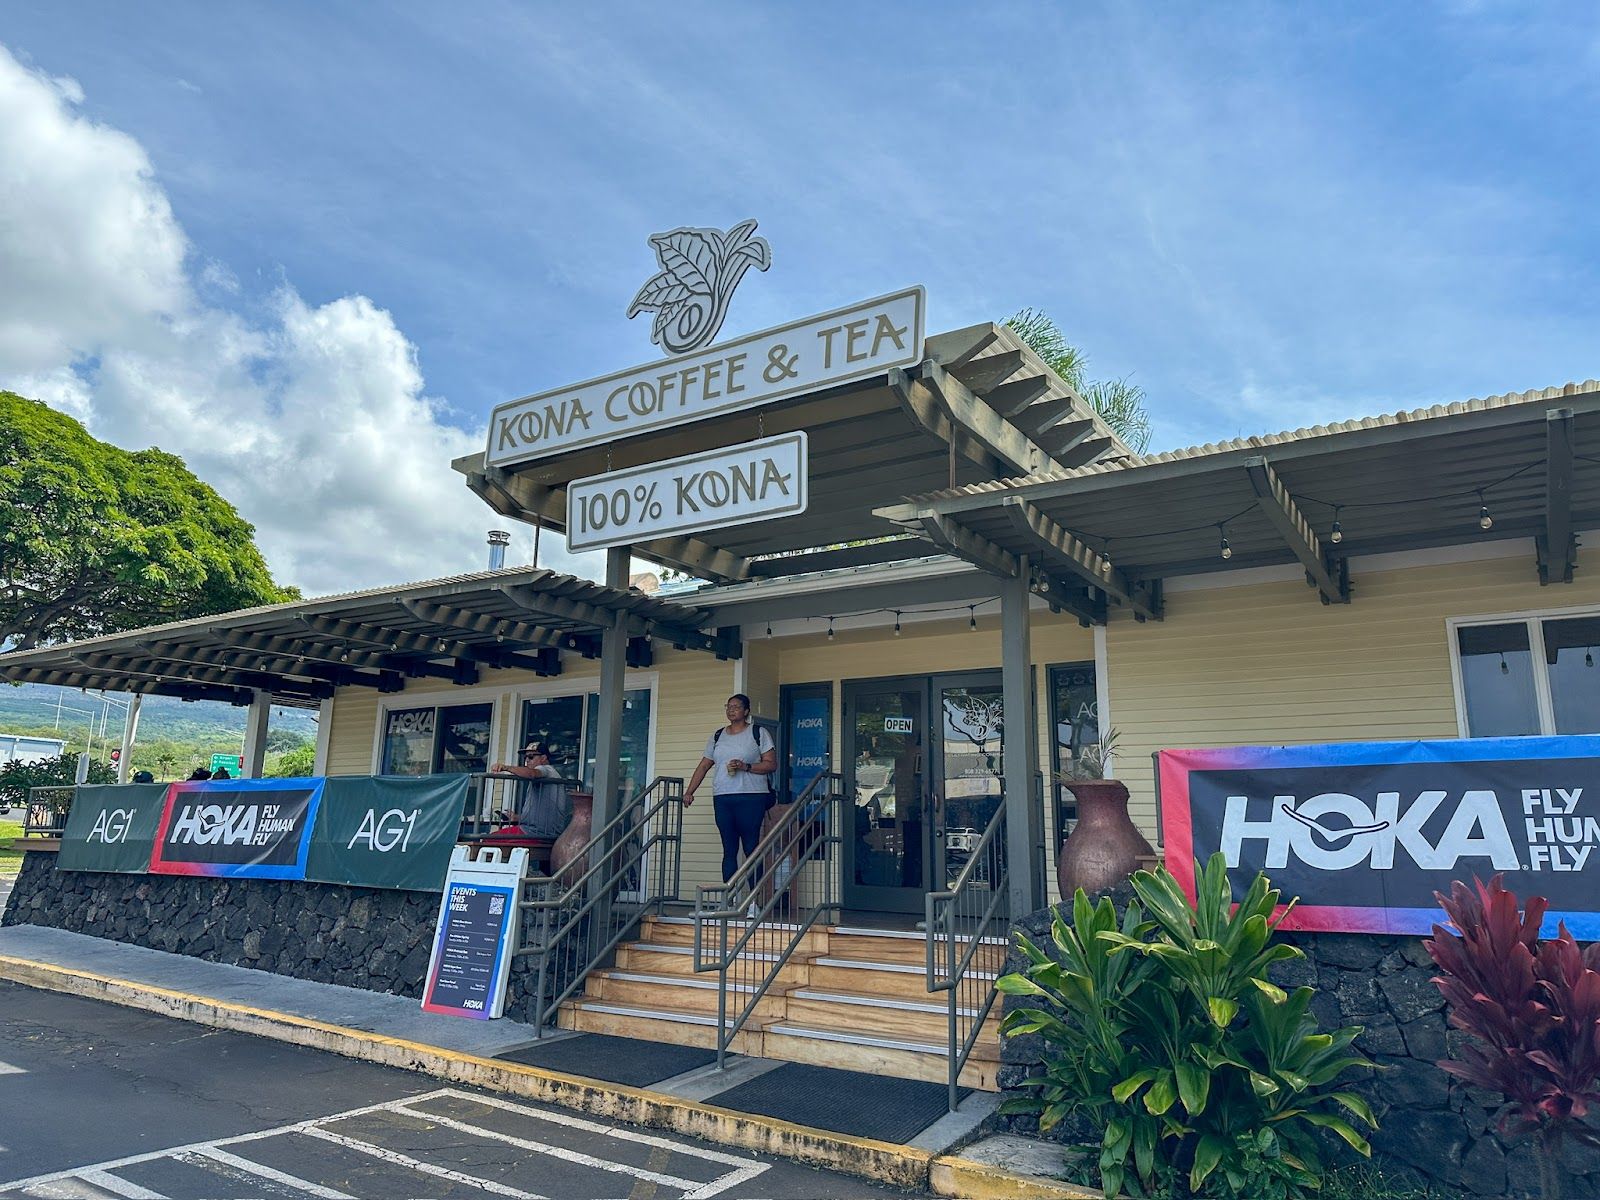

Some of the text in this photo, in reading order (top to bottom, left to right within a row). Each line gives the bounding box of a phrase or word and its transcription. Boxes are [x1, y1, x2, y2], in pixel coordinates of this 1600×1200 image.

[498, 314, 908, 451] KONA COFFEE & TEA
[577, 458, 791, 534] 100% KONA
[388, 711, 434, 734] HOKA
[797, 718, 823, 729] HOKA
[886, 719, 911, 731] OPEN
[797, 756, 823, 767] HOKA
[1521, 788, 1583, 814] FLY
[262, 805, 280, 819] FLY
[169, 804, 258, 846] HOKA
[257, 818, 297, 832] HUMAN
[1220, 790, 1521, 870] HOKA
[252, 832, 272, 846] FLY
[1529, 845, 1592, 871] FLY
[451, 887, 477, 896] EVENTS
[450, 895, 466, 904] THIS
[449, 902, 469, 912] WEEK
[462, 999, 484, 1010] HOKA
